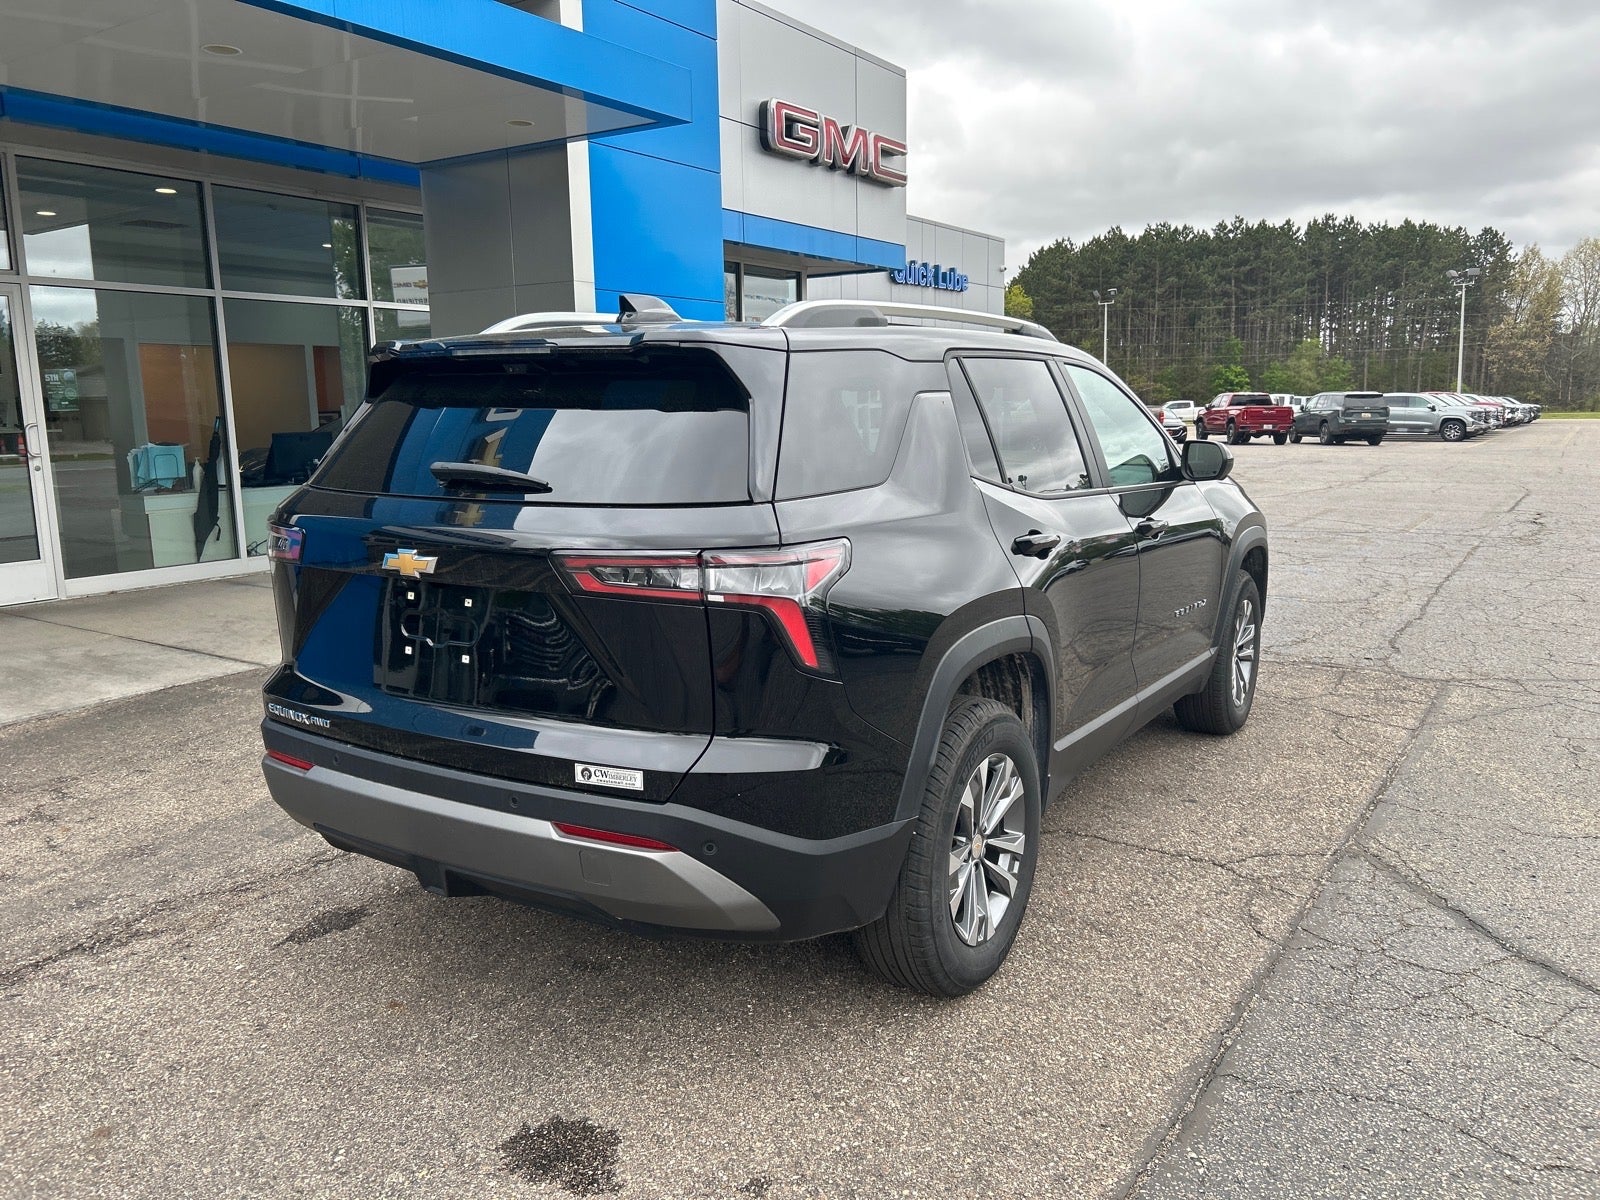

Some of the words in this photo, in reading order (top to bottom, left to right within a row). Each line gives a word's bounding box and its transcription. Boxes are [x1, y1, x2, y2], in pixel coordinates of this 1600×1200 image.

[763, 98, 907, 187] GMC
[893, 261, 936, 288] Quick
[937, 266, 969, 292] Lube
[268, 702, 310, 725] EQUINOX
[310, 716, 331, 729] AWD
